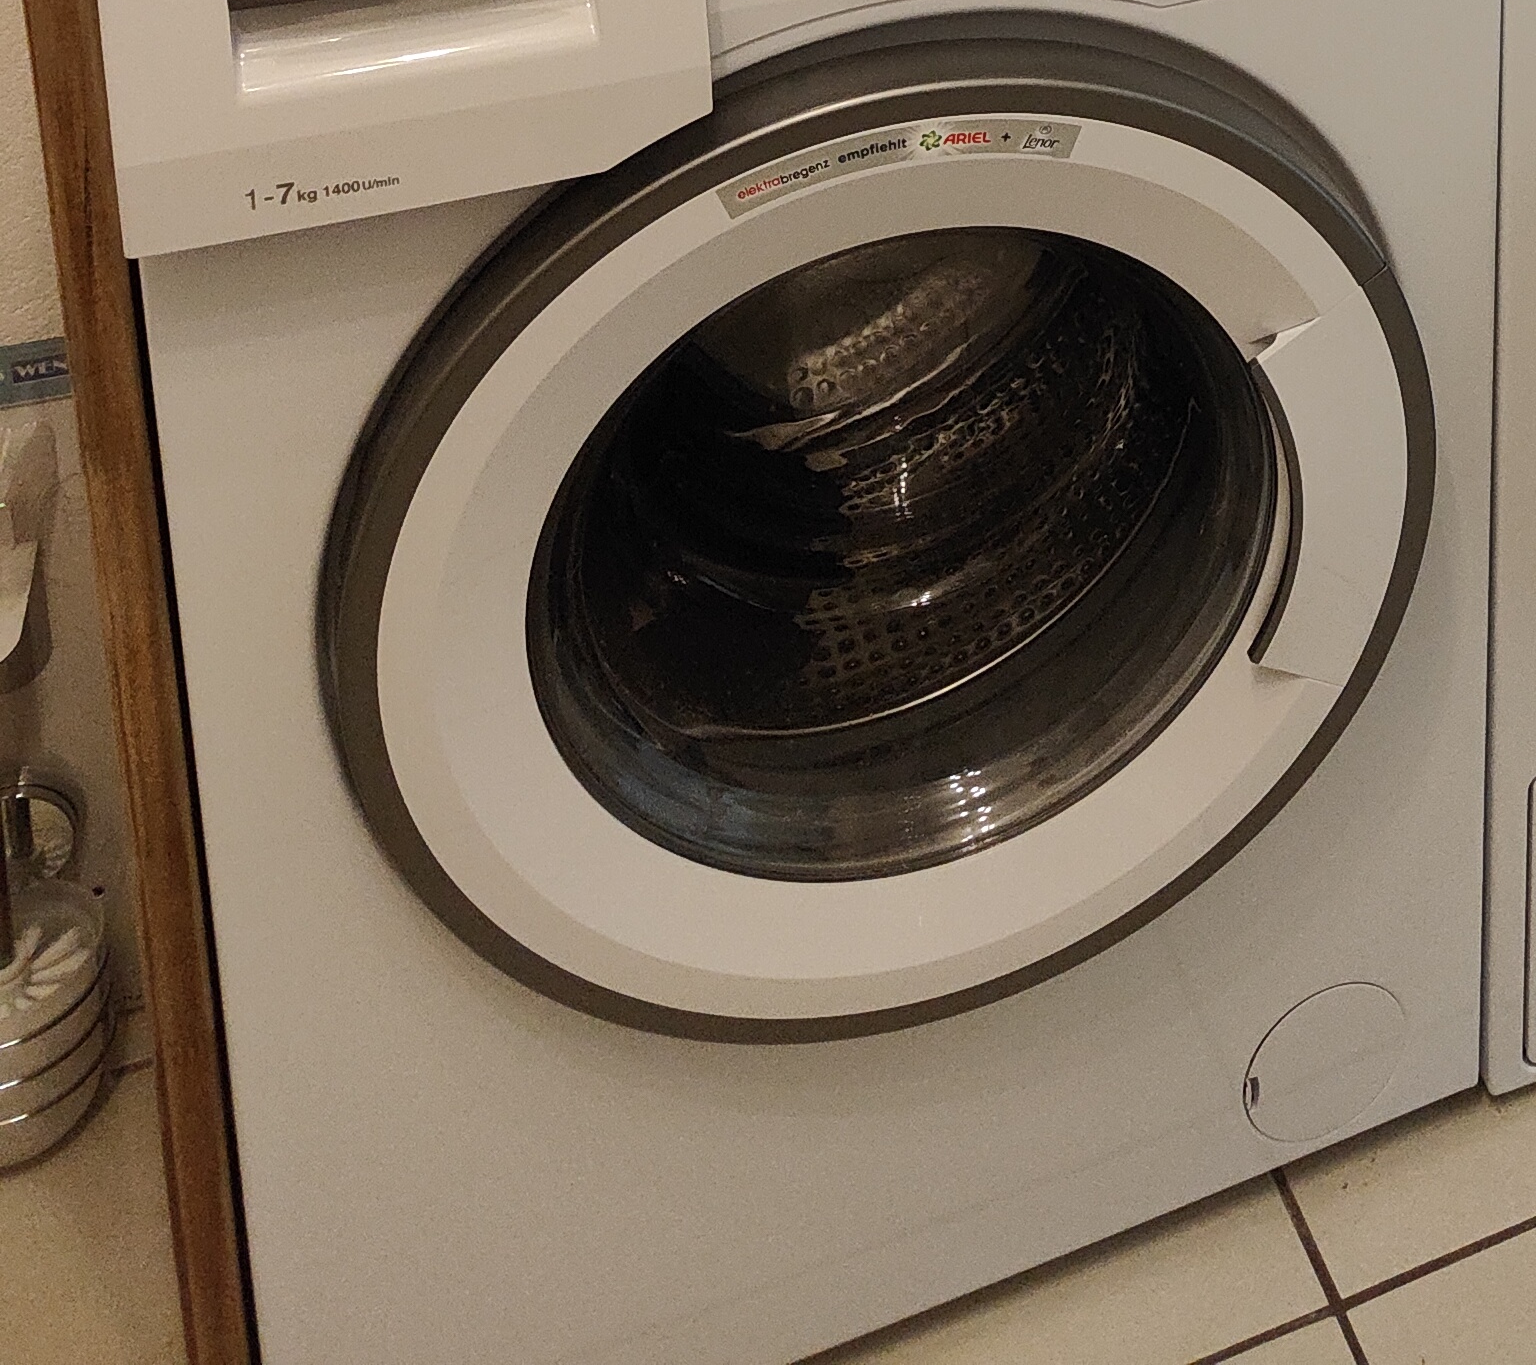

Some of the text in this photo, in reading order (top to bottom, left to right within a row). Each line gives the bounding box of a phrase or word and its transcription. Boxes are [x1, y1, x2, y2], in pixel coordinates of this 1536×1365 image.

[737, 158, 831, 200] elektrabregenz
[837, 137, 908, 164] empfiehlt
[942, 131, 992, 146] ARIEL
[1022, 132, 1060, 150] Lenor
